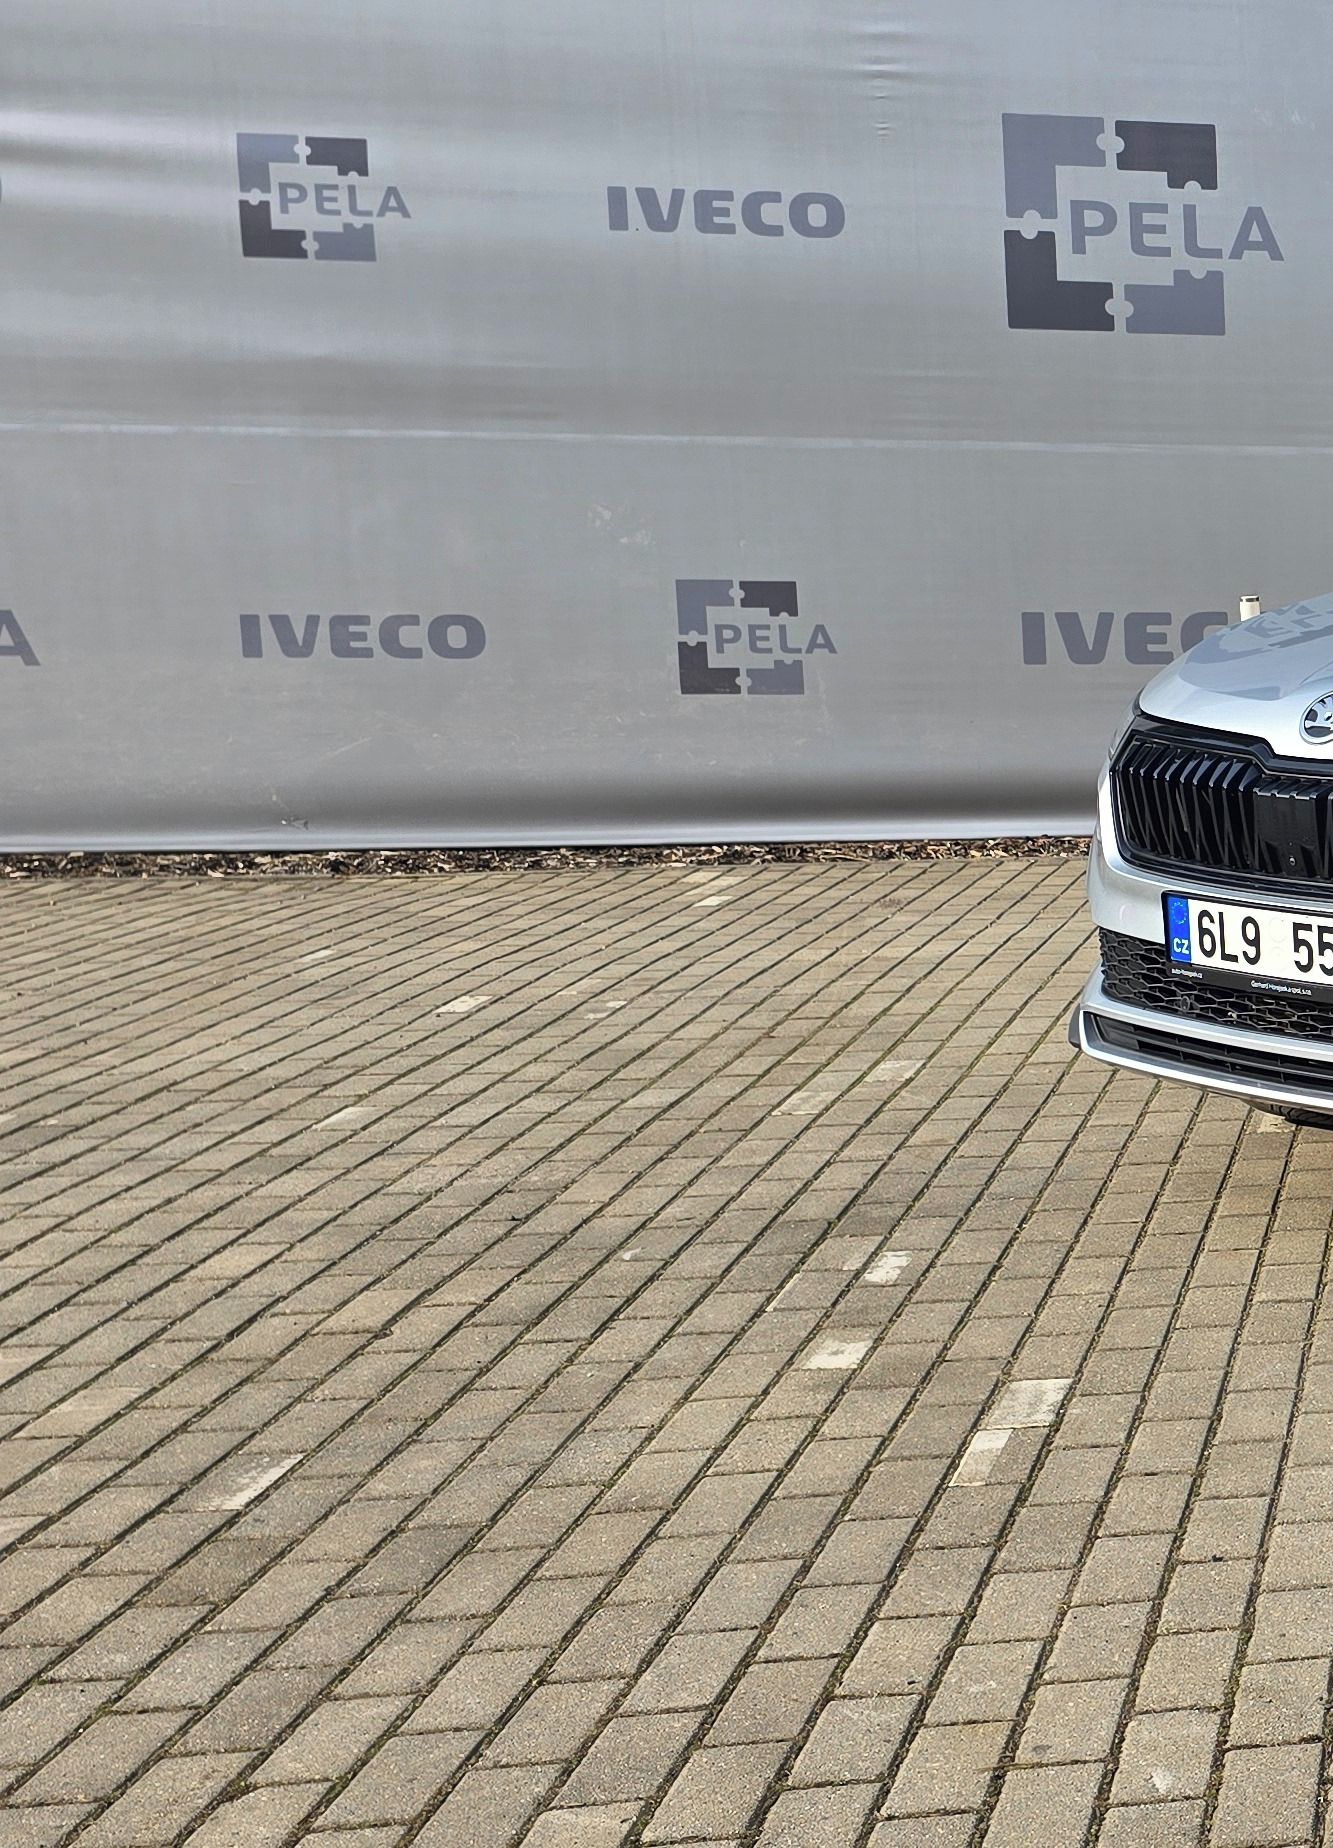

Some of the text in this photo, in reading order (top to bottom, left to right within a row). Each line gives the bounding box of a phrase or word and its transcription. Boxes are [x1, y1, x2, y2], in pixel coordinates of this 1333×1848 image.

[279, 182, 411, 218] PELA
[607, 186, 845, 238] IVECO
[1070, 200, 1284, 261] PELA
[240, 614, 486, 659] IVECO
[715, 624, 837, 654] PELA
[1021, 611, 1234, 665] IVEC
[1173, 937, 1190, 954] CZ
[1197, 909, 1261, 965] 6L9
